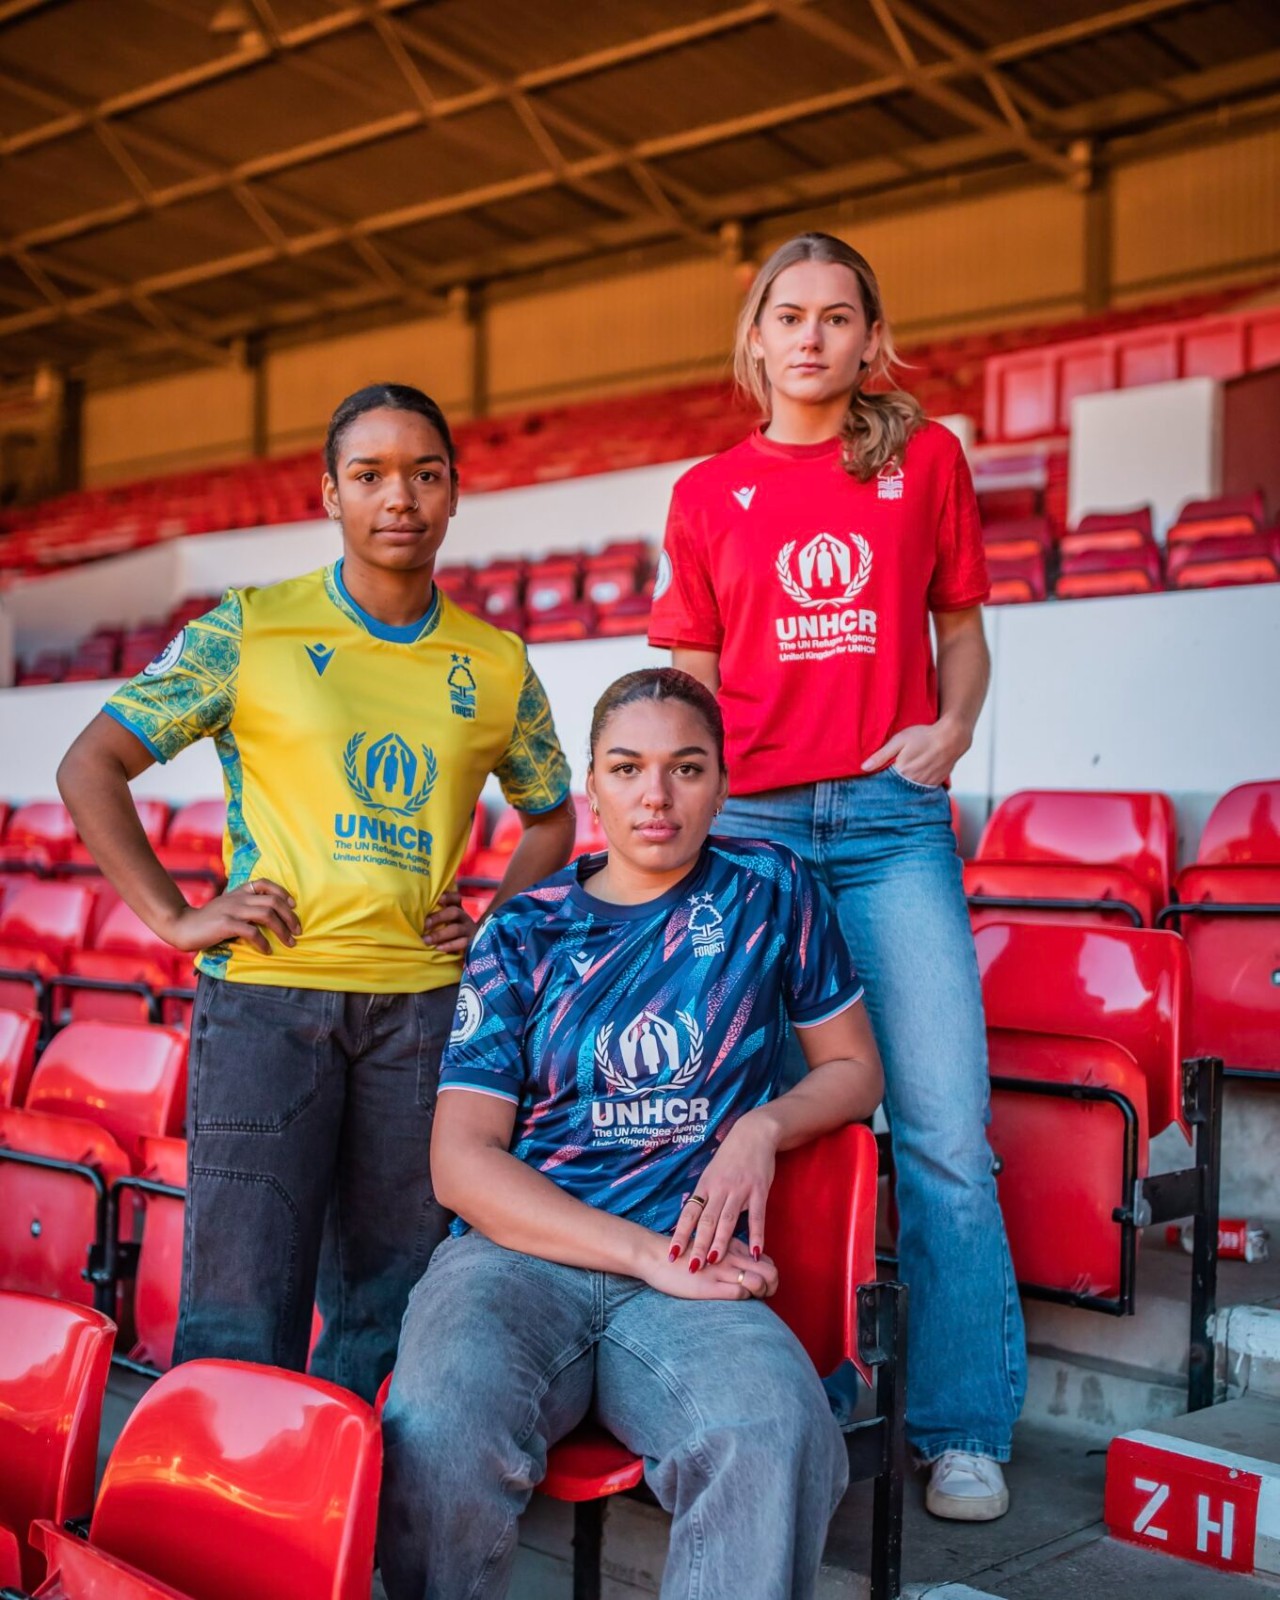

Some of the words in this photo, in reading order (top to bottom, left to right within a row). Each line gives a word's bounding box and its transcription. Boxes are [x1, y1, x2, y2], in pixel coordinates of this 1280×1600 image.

[776, 609, 877, 640] UNHCR
[779, 642, 796, 651] The
[797, 641, 811, 649] UN
[812, 636, 844, 648] Refugee
[845, 633, 876, 645] Agency
[779, 652, 805, 662] United
[847, 644, 876, 654] UNHCR
[334, 813, 434, 856] UNHCR
[333, 853, 361, 862] United
[363, 855, 398, 867] Kingdom
[335, 840, 352, 849] The
[354, 841, 370, 850] UN
[371, 843, 404, 858] Refugee
[406, 852, 431, 868] Agency
[592, 1097, 710, 1127] UNHCR
[592, 1128, 612, 1138] The
[614, 1127, 629, 1137] UN
[630, 1125, 671, 1137] Refugee
[673, 1124, 707, 1135] Agency
[618, 1137, 659, 1148] Kingdom
[672, 1134, 705, 1143] UNHCR
